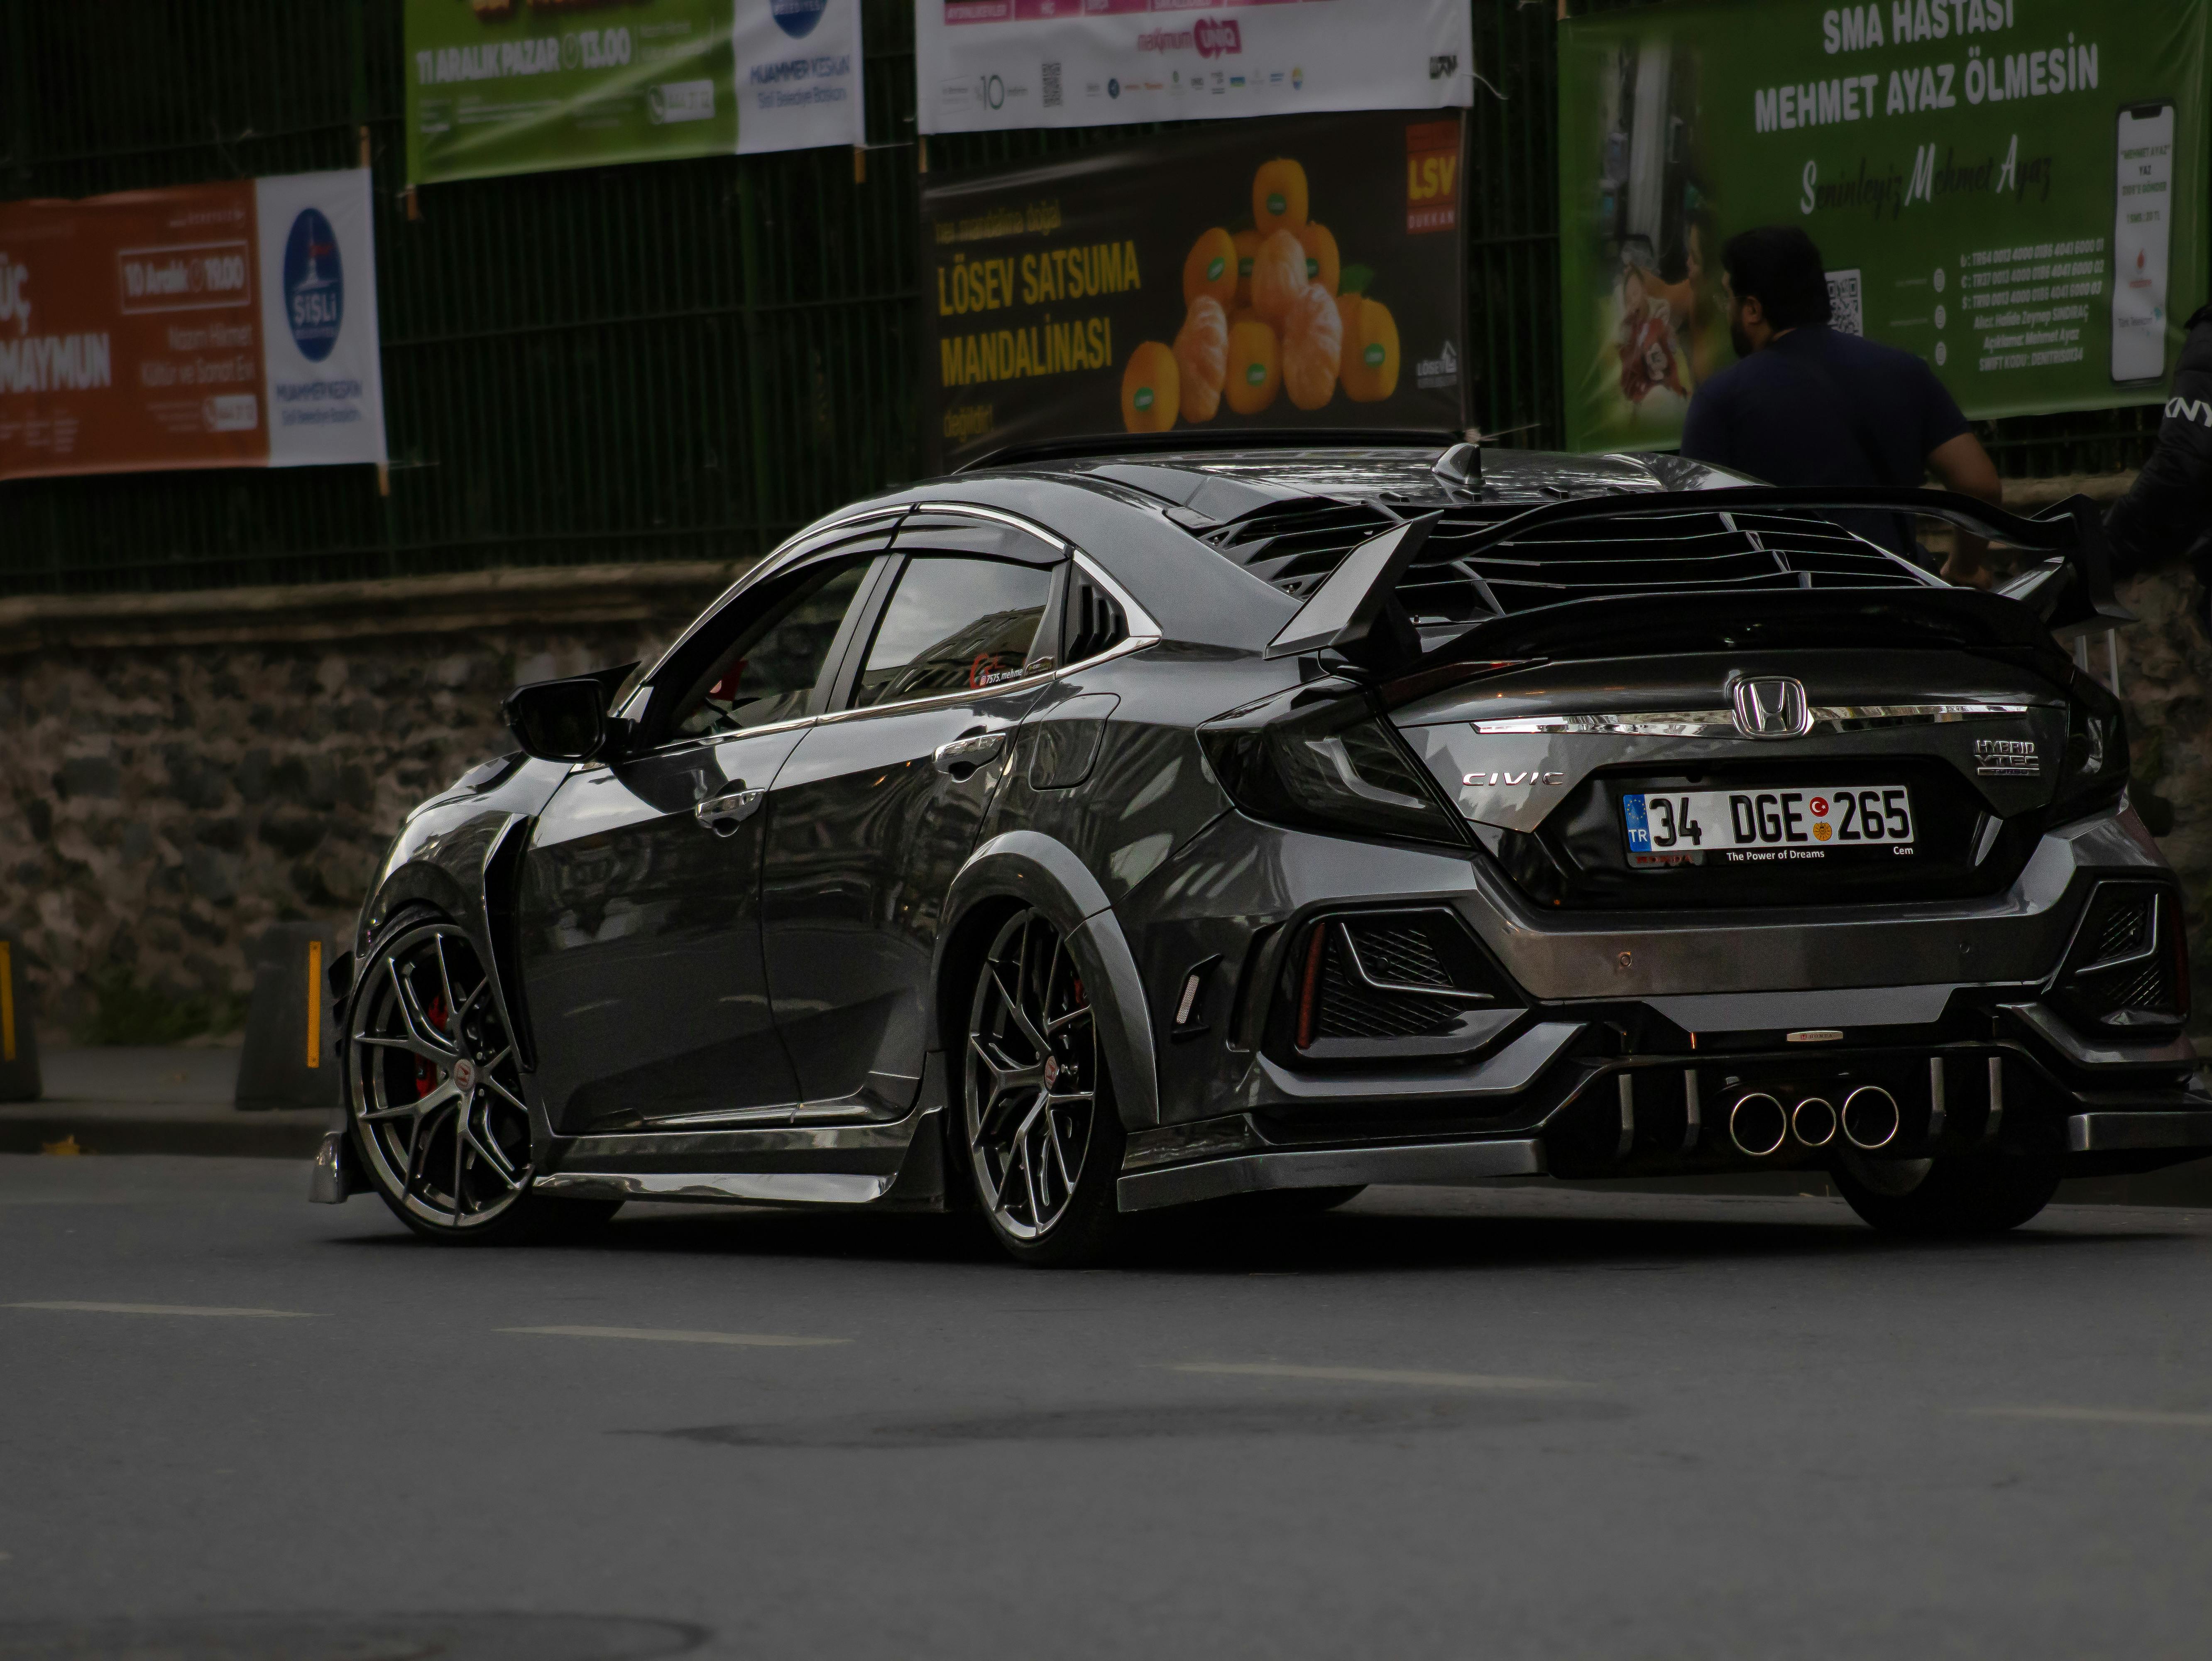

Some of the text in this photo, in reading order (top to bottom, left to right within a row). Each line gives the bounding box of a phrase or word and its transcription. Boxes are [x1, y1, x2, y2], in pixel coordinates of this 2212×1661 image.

[1823, 4, 1884, 54] SMA
[436, 43, 500, 83] ARALIK
[502, 37, 560, 76] PAZAR
[1754, 32, 2099, 133] MEHMET AYAZ ÖLMESİN
[1409, 156, 1456, 200] LSV
[938, 240, 1141, 316] LÖSEV SATSUMA
[940, 314, 1112, 387] MANDALİNASI
[1974, 755, 2039, 767] VTEC
[1976, 739, 2035, 754] HYBRID
[1462, 771, 1564, 786] CIVIC
[1628, 791, 1912, 848] TR 34 DGE 265
[1726, 850, 1825, 862] The Power of Dreams
[1893, 845, 1914, 855] Cem
